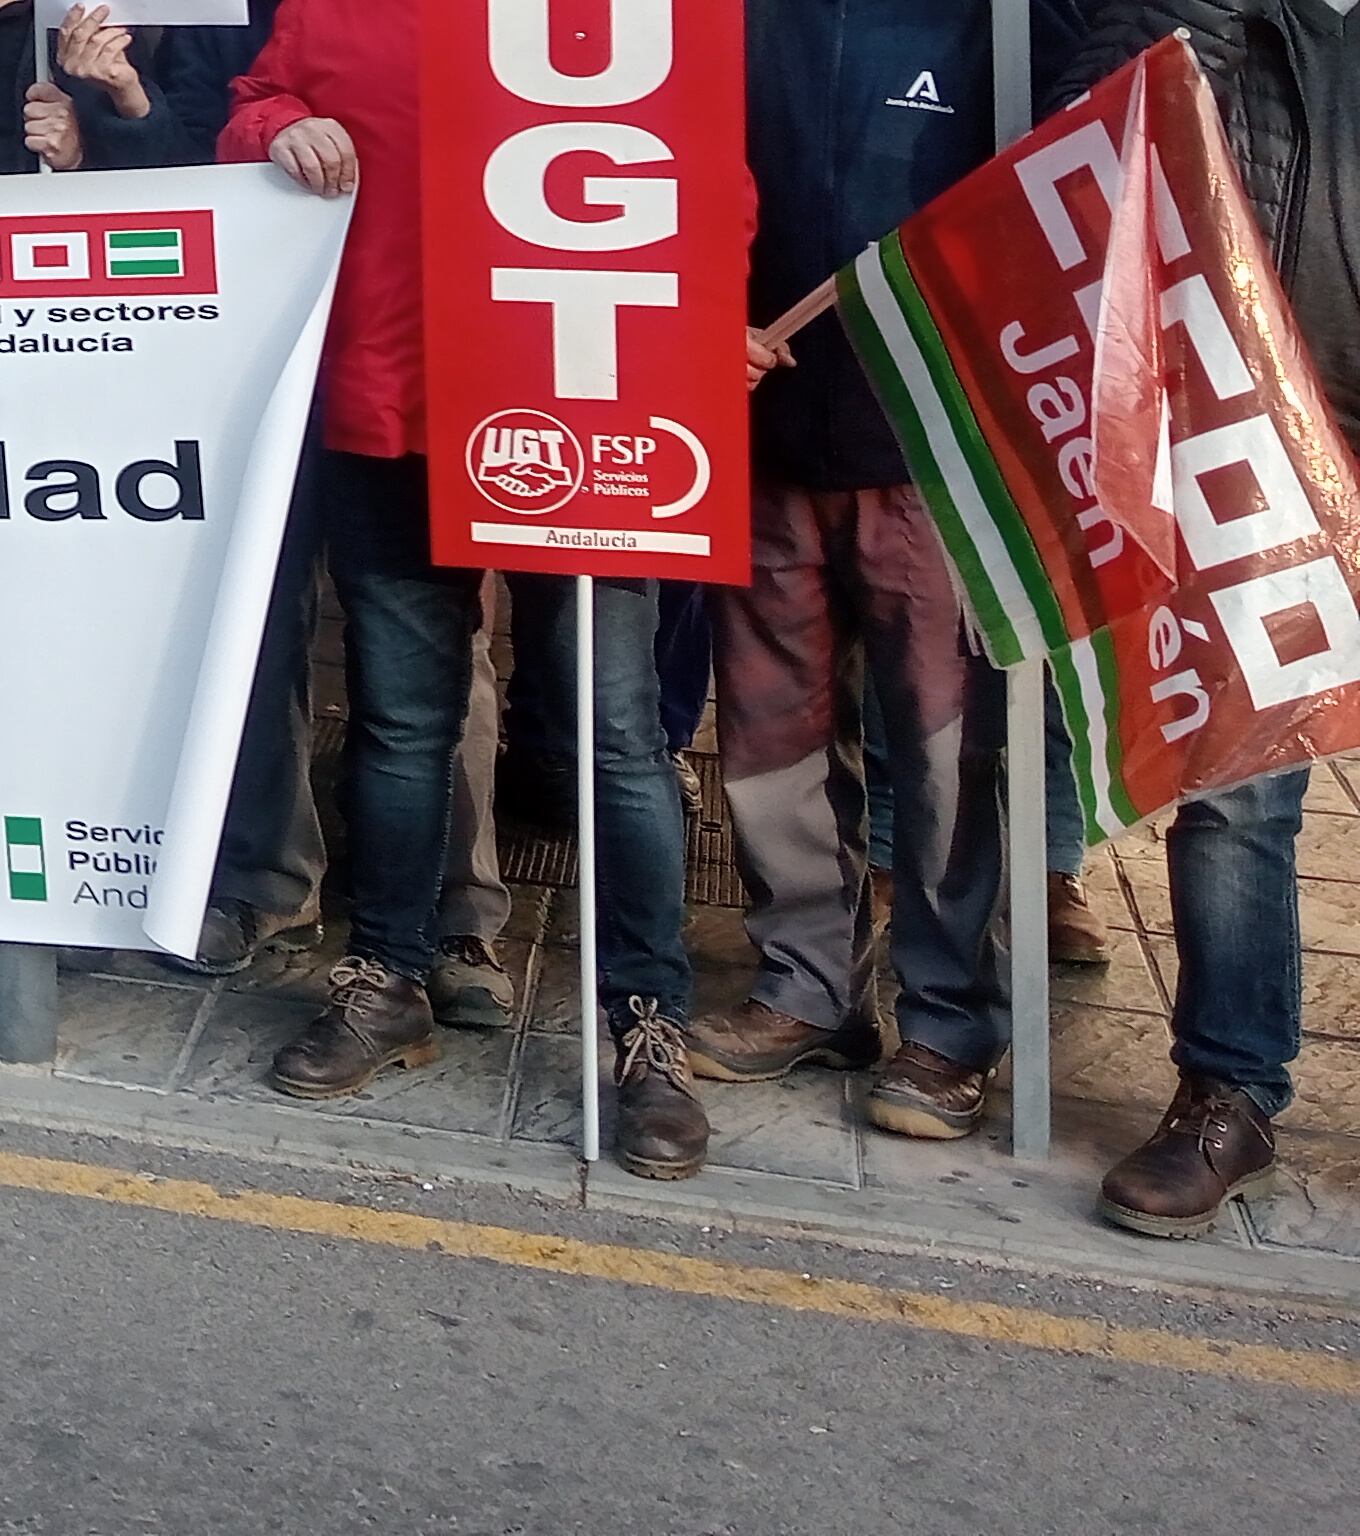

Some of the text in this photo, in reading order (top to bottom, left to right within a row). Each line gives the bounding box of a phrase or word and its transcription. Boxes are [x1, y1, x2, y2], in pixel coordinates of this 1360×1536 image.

[14, 307, 36, 328] y
[46, 302, 220, 324] sectores
[482, 427, 657, 468] UGT FSP
[593, 469, 649, 483] Servicios
[593, 482, 650, 498] Públicos
[545, 529, 638, 548] Andalucía
[65, 820, 165, 846] Servic
[68, 850, 157, 876] Públi
